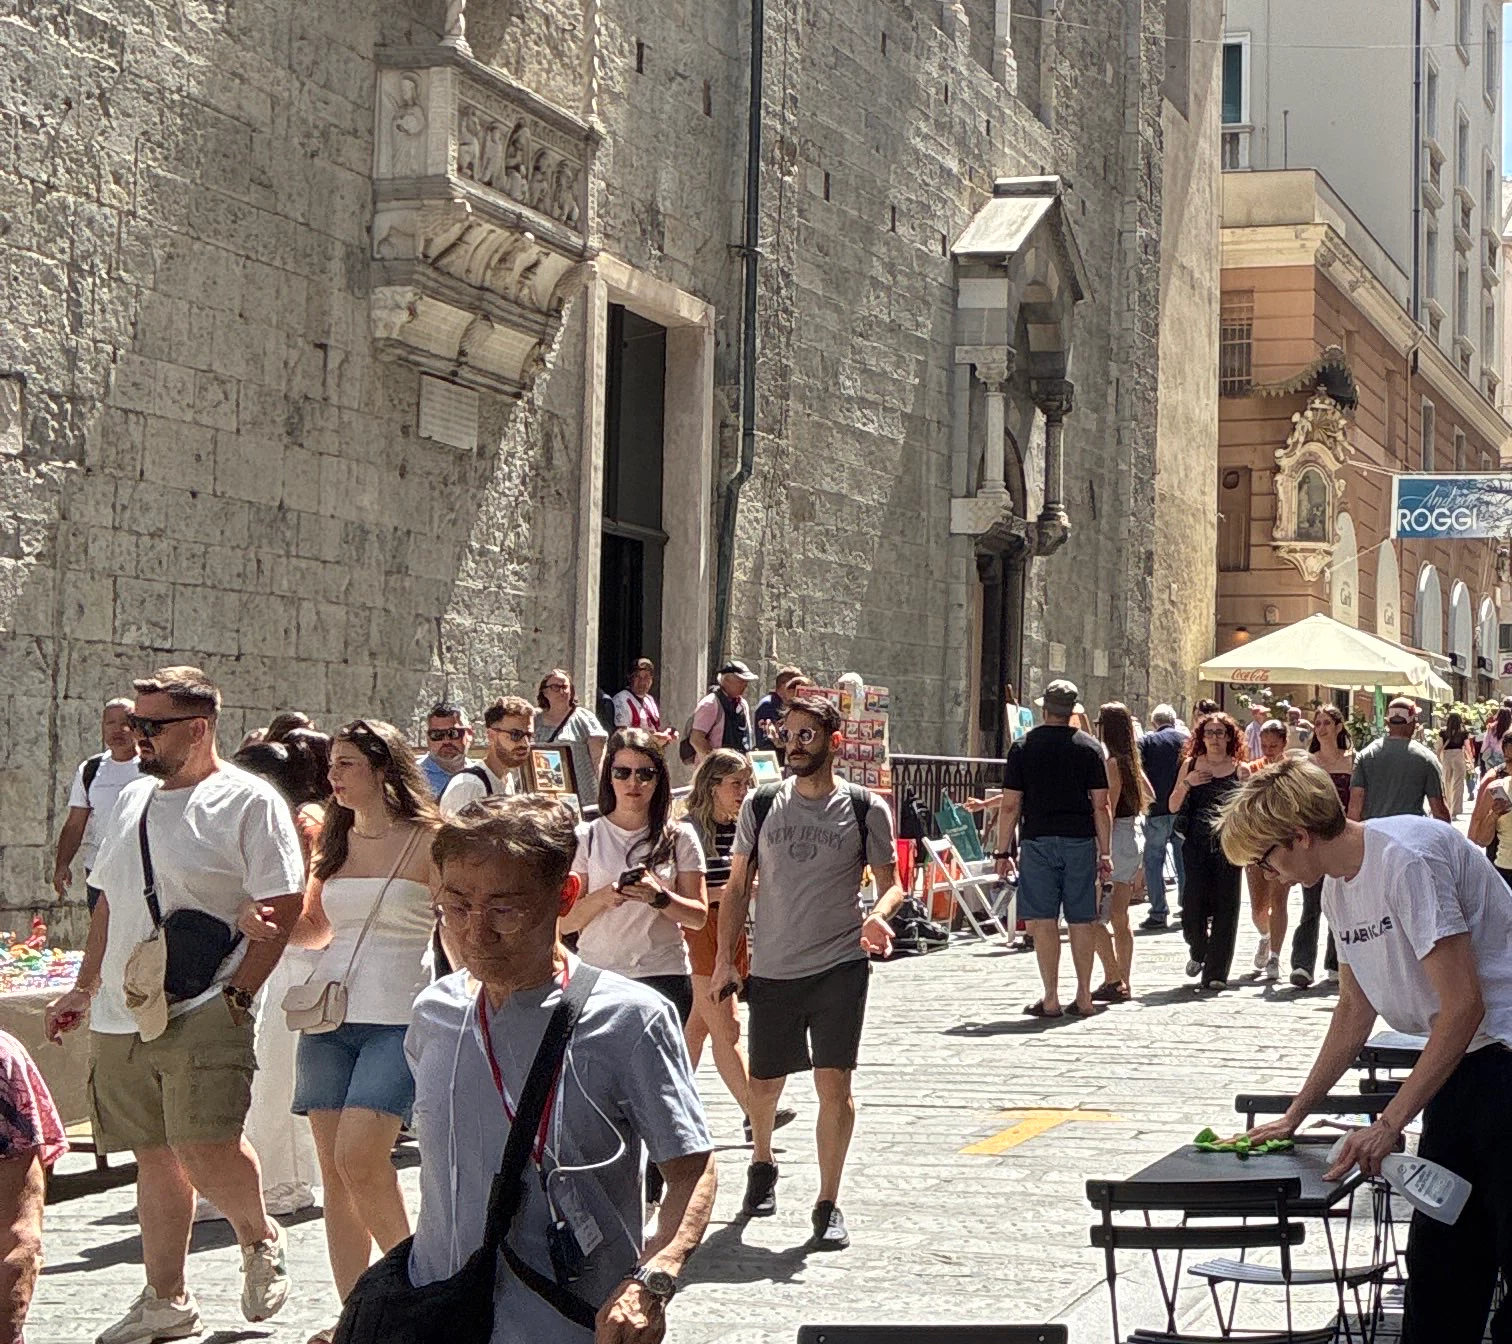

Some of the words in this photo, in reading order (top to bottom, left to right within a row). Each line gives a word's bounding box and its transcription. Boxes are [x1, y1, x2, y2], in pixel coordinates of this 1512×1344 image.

[1397, 507, 1478, 532] ROGGI
[766, 825, 796, 848] NEW
[800, 825, 844, 850] JERSEY
